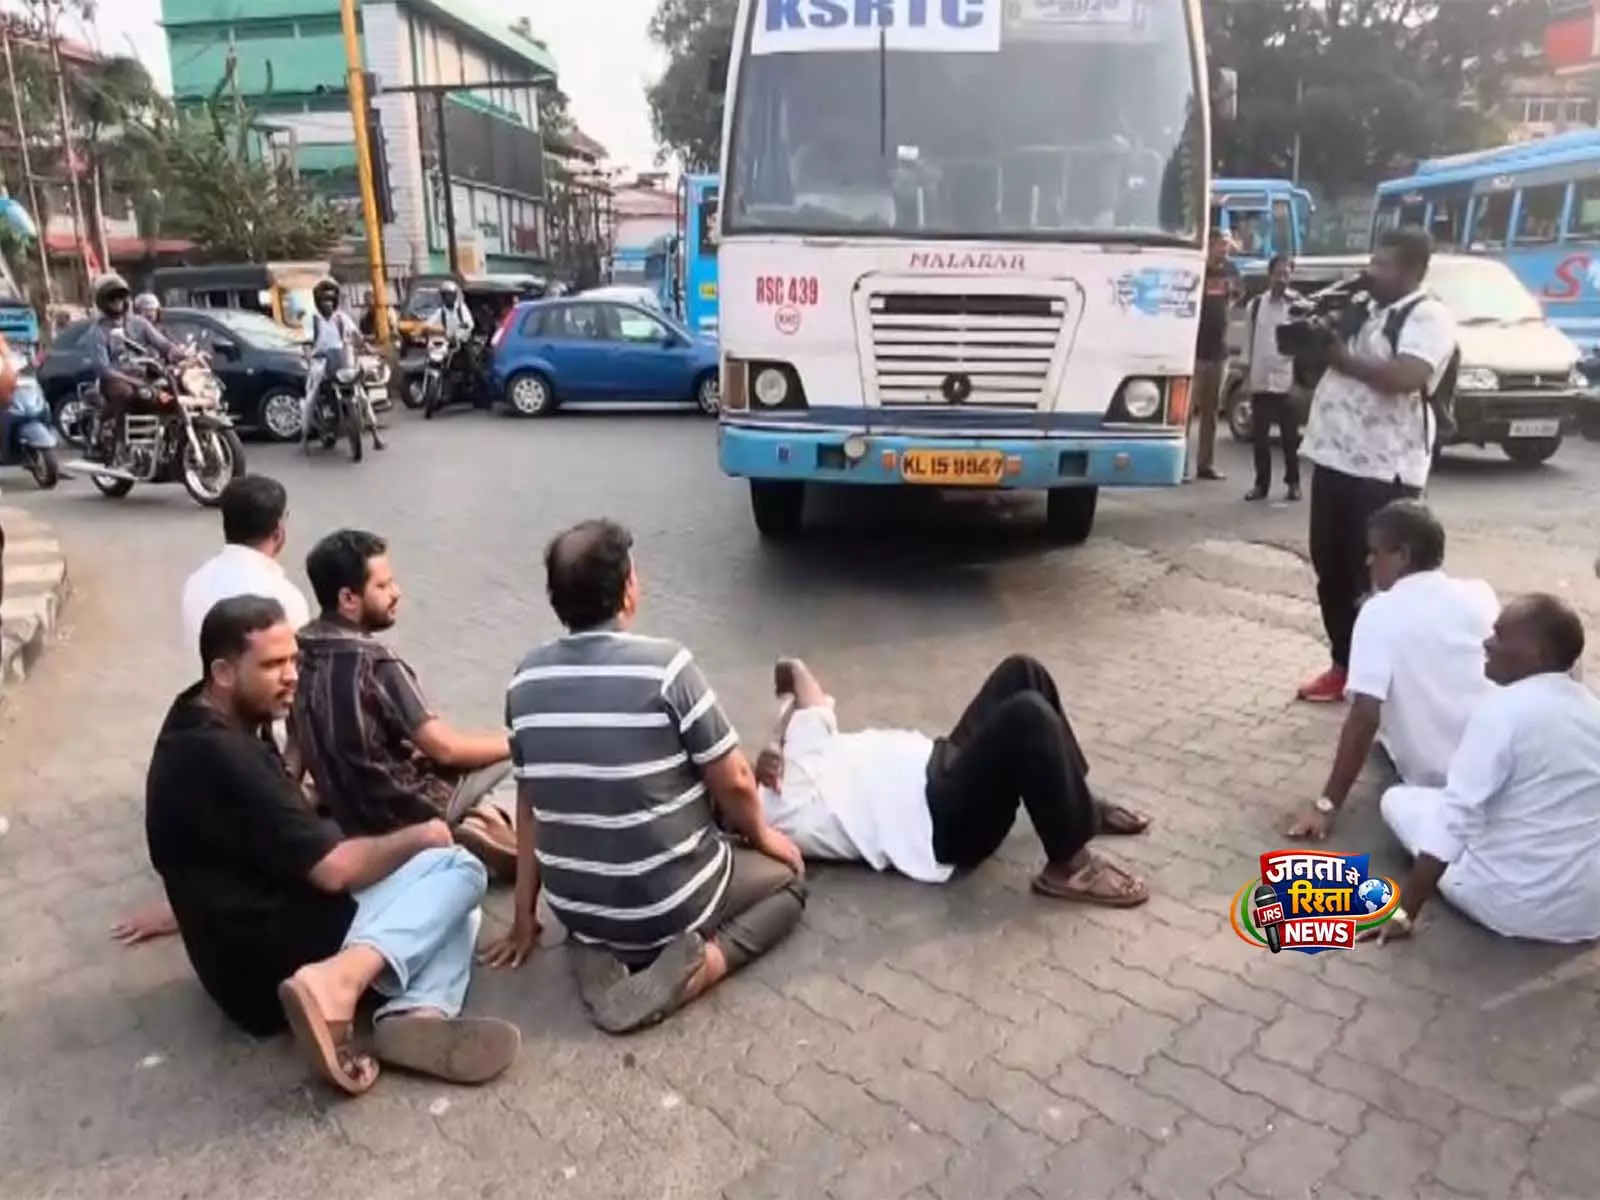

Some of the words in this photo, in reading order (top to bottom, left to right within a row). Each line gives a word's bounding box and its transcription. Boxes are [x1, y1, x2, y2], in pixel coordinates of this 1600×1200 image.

[756, 275, 784, 305] RSC
[788, 275, 818, 305] 439
[903, 456, 926, 475] KL
